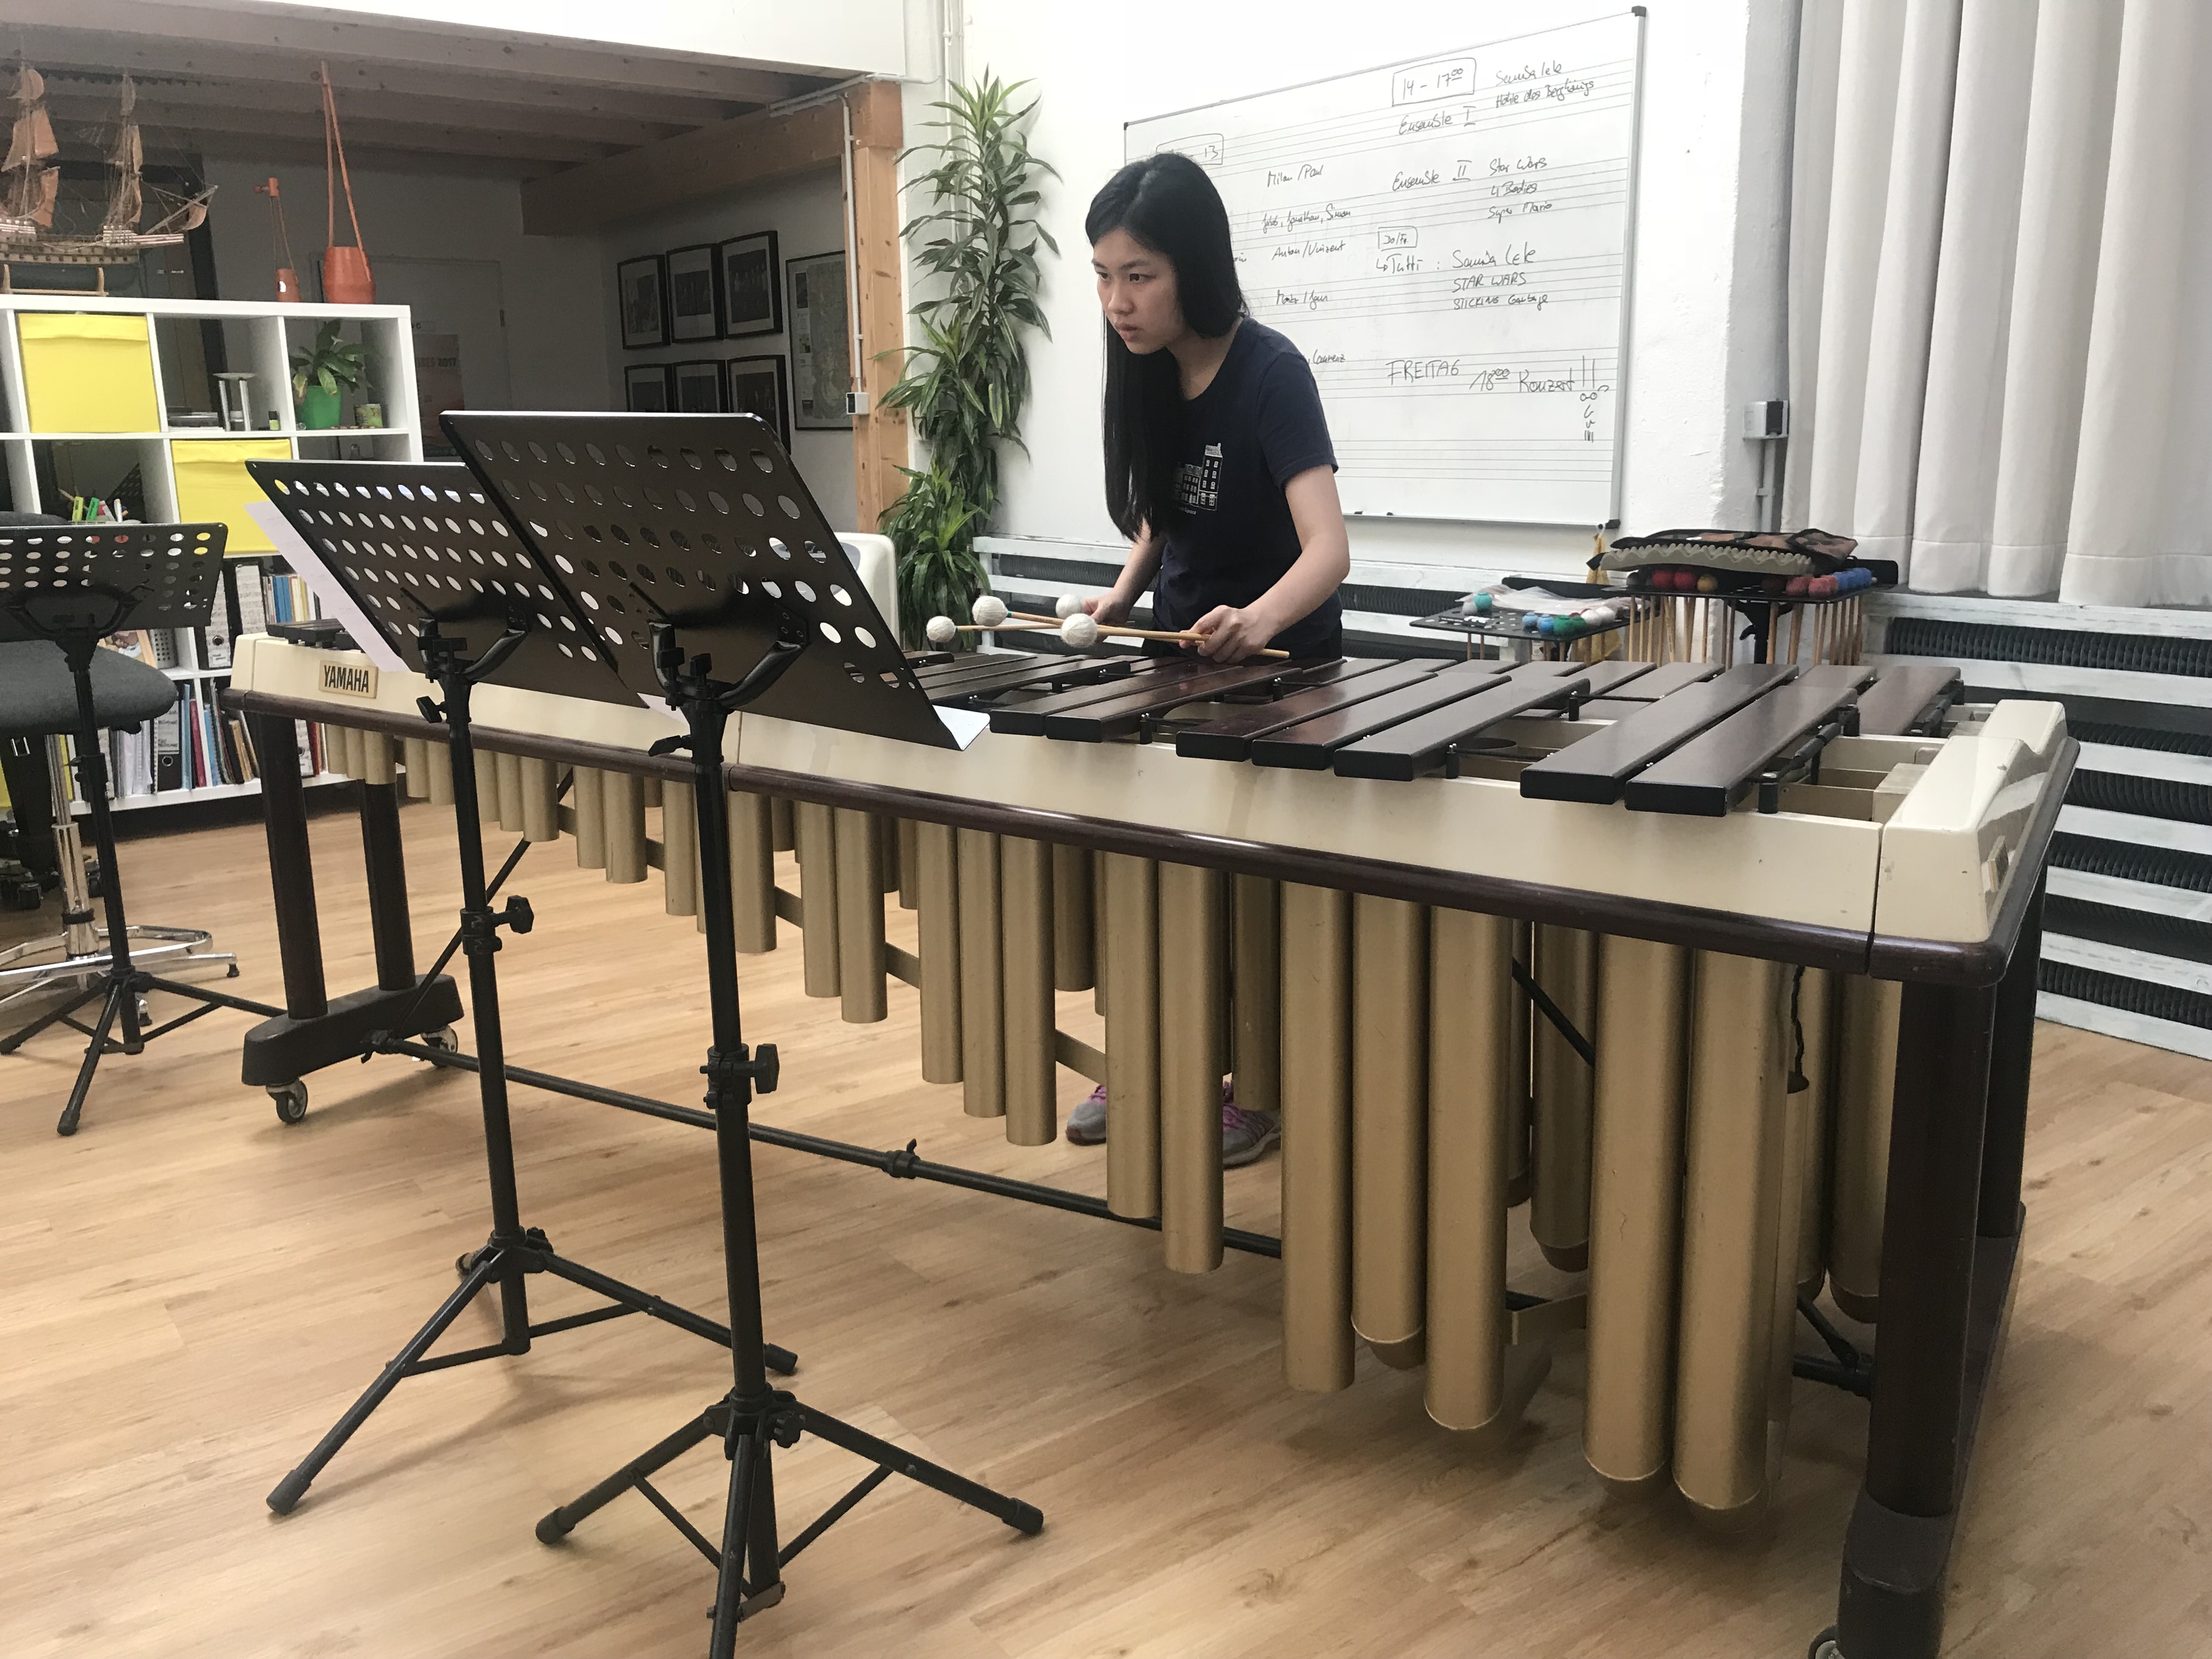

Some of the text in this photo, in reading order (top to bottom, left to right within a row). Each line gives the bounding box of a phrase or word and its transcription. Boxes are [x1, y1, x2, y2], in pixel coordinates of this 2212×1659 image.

[1402, 78, 1414, 100] 14
[1523, 88, 1541, 103] des
[1489, 157, 1510, 176] Star
[1516, 155, 1548, 170] Wars
[1522, 200, 1553, 213] Mario
[1452, 272, 1527, 293] STAR WARS
[1453, 296, 1499, 311] STICKING
[324, 665, 369, 693] YAMAHA
